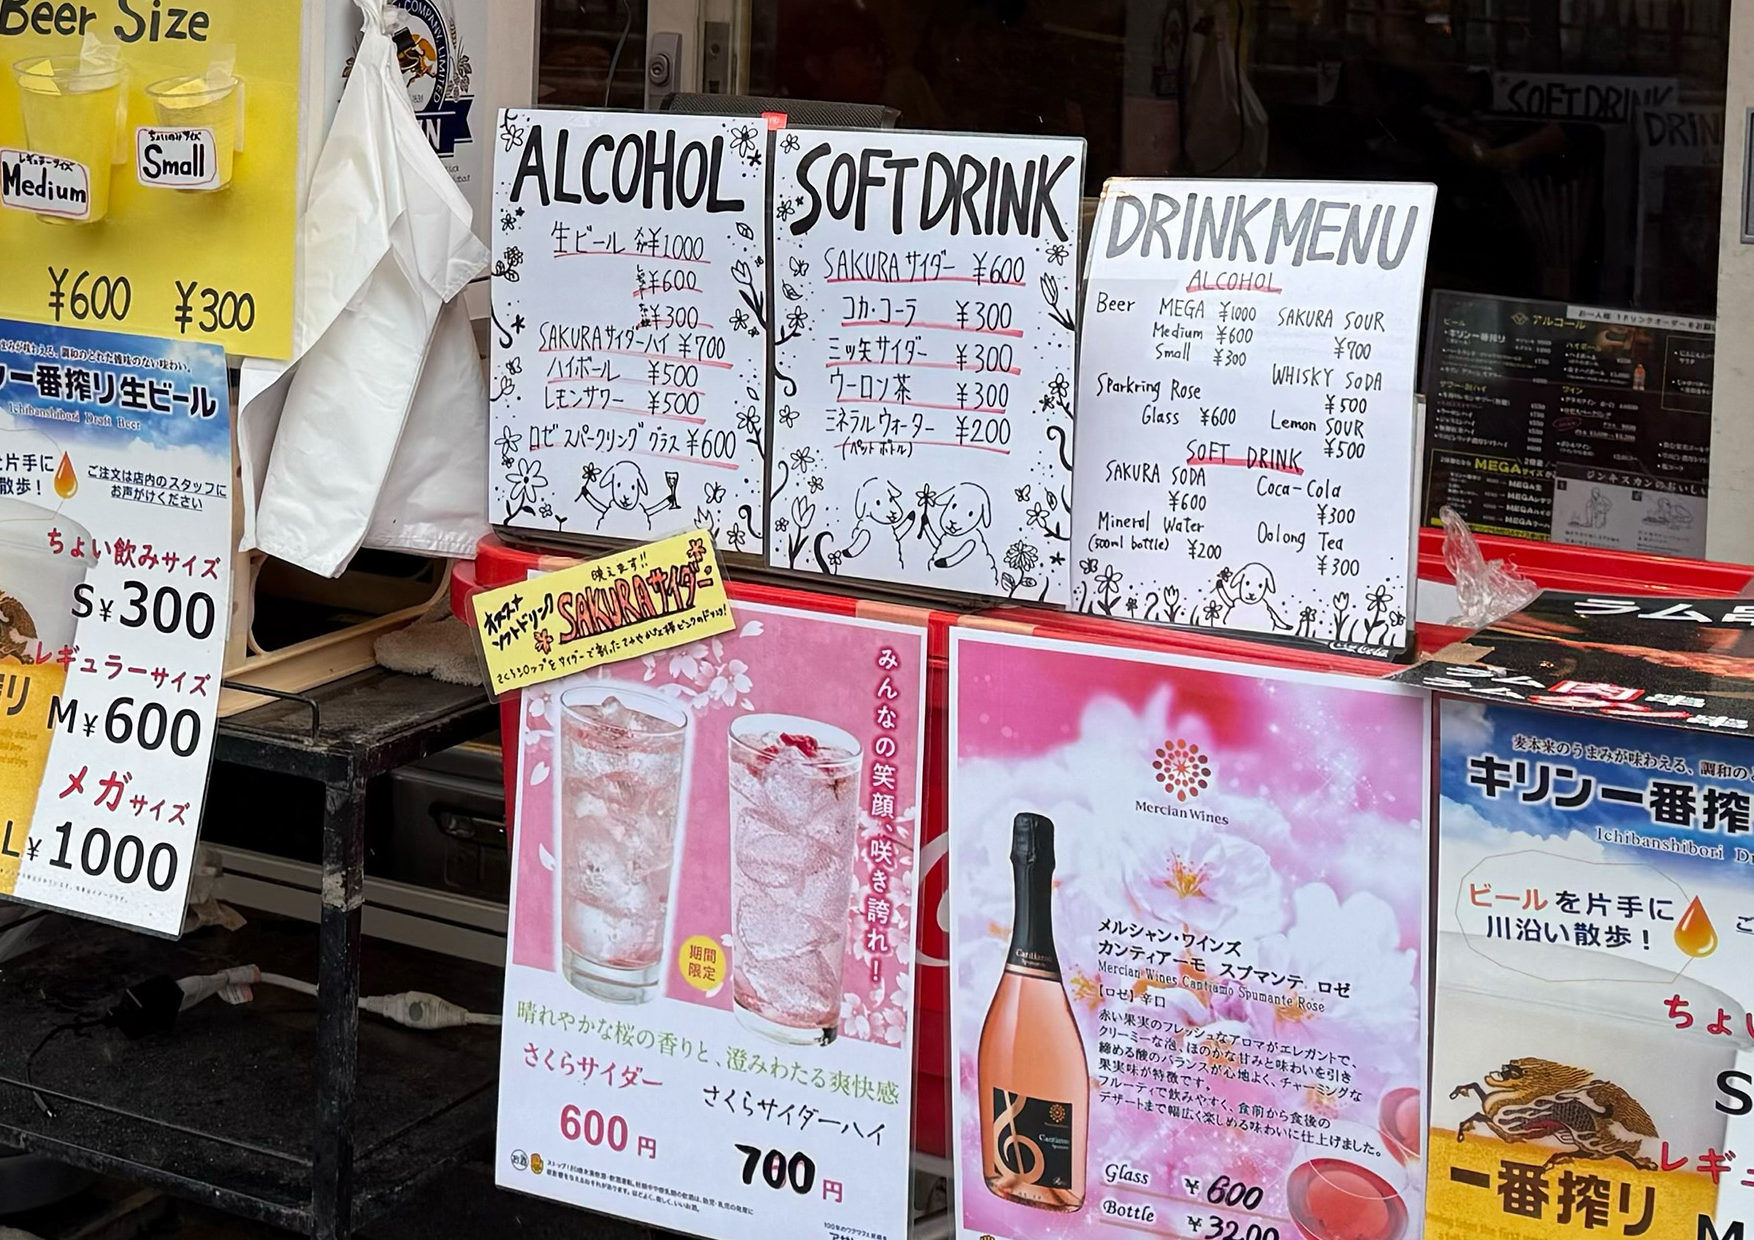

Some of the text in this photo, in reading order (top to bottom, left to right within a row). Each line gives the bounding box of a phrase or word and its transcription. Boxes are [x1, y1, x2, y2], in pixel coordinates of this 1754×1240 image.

[433, 46, 446, 103] LIMITED
[143, 143, 204, 178] Small
[509, 125, 745, 213] ALCOHOL
[2, 161, 86, 203] Medium
[551, 221, 626, 254] 生ビール
[649, 270, 697, 292] ¥600
[973, 252, 1024, 285] ¥600
[1191, 271, 1276, 291] ALCOHOL
[48, 268, 132, 322] ¥600
[175, 282, 256, 334] ¥300
[1097, 293, 1257, 322] Beer MEGA ¥1000
[956, 300, 1012, 331] ¥300
[1277, 306, 1385, 332] SAKURA SOUR
[1533, 314, 1586, 331] アルコール
[679, 333, 725, 360] ¥700
[1152, 322, 1253, 345] Medium ¥600
[956, 344, 1013, 372] ¥300
[1155, 343, 1246, 367] Small ¥300
[1333, 336, 1372, 360] ¥700
[547, 357, 698, 387] ハイボール ¥500
[1272, 363, 1334, 387] WHISKY
[545, 386, 699, 415] レモンサワー ¥500
[830, 368, 1008, 409] ウーロン茶 ¥300
[1171, 381, 1201, 400] Rose
[8, 402, 141, 430] Ichibanshibori Draft Beer
[1142, 405, 1236, 426] Glass ¥600
[1324, 393, 1367, 415] ¥500
[956, 416, 1011, 445] ¥200
[1271, 409, 1364, 439] Lemon SOUR
[687, 428, 737, 458] ¥600
[1186, 440, 1303, 473] SOFT DRINK
[1323, 438, 1366, 460] ¥500
[87, 465, 227, 498] ご注文は店内のスタッフに
[1105, 461, 1206, 487] SAKURA SODA
[1256, 476, 1341, 499] Coca-Cola
[111, 485, 203, 511] お声がけください
[1168, 491, 1207, 511] ¥600
[1098, 510, 1204, 535] Mineral Water
[1317, 505, 1355, 526] ¥300
[1188, 540, 1222, 560] ¥200
[1257, 522, 1344, 553] Oolong Tea
[47, 528, 221, 581] ちょい飲みサイズ
[1317, 556, 1360, 577] ¥300
[35, 641, 212, 697] レギュラーサイズ
[58, 766, 190, 827] メガサイズ
[1135, 800, 1230, 826] Mercian Wines
[1597, 828, 1723, 860] Ichibanshibori
[1098, 918, 1242, 957] メルシャン・ワインズ
[688, 945, 718, 963] 期間
[687, 963, 718, 981] 限定
[1098, 940, 1206, 973] カンティアーモ
[1220, 961, 1304, 990] スプマンテ
[1318, 980, 1351, 999] ロゼ
[1098, 960, 1140, 979] Mercian
[1145, 968, 1178, 986] Wines
[1238, 986, 1293, 1008] Spumante
[1298, 996, 1325, 1013] Rose
[523, 1042, 664, 1089] さくらサイダー
[703, 1085, 886, 1146] さくらサイダーハイ
[1105, 1164, 1149, 1185] Glass
[1450, 1159, 1655, 1236] 一番搾り
[1103, 1201, 1155, 1223] Bottle
